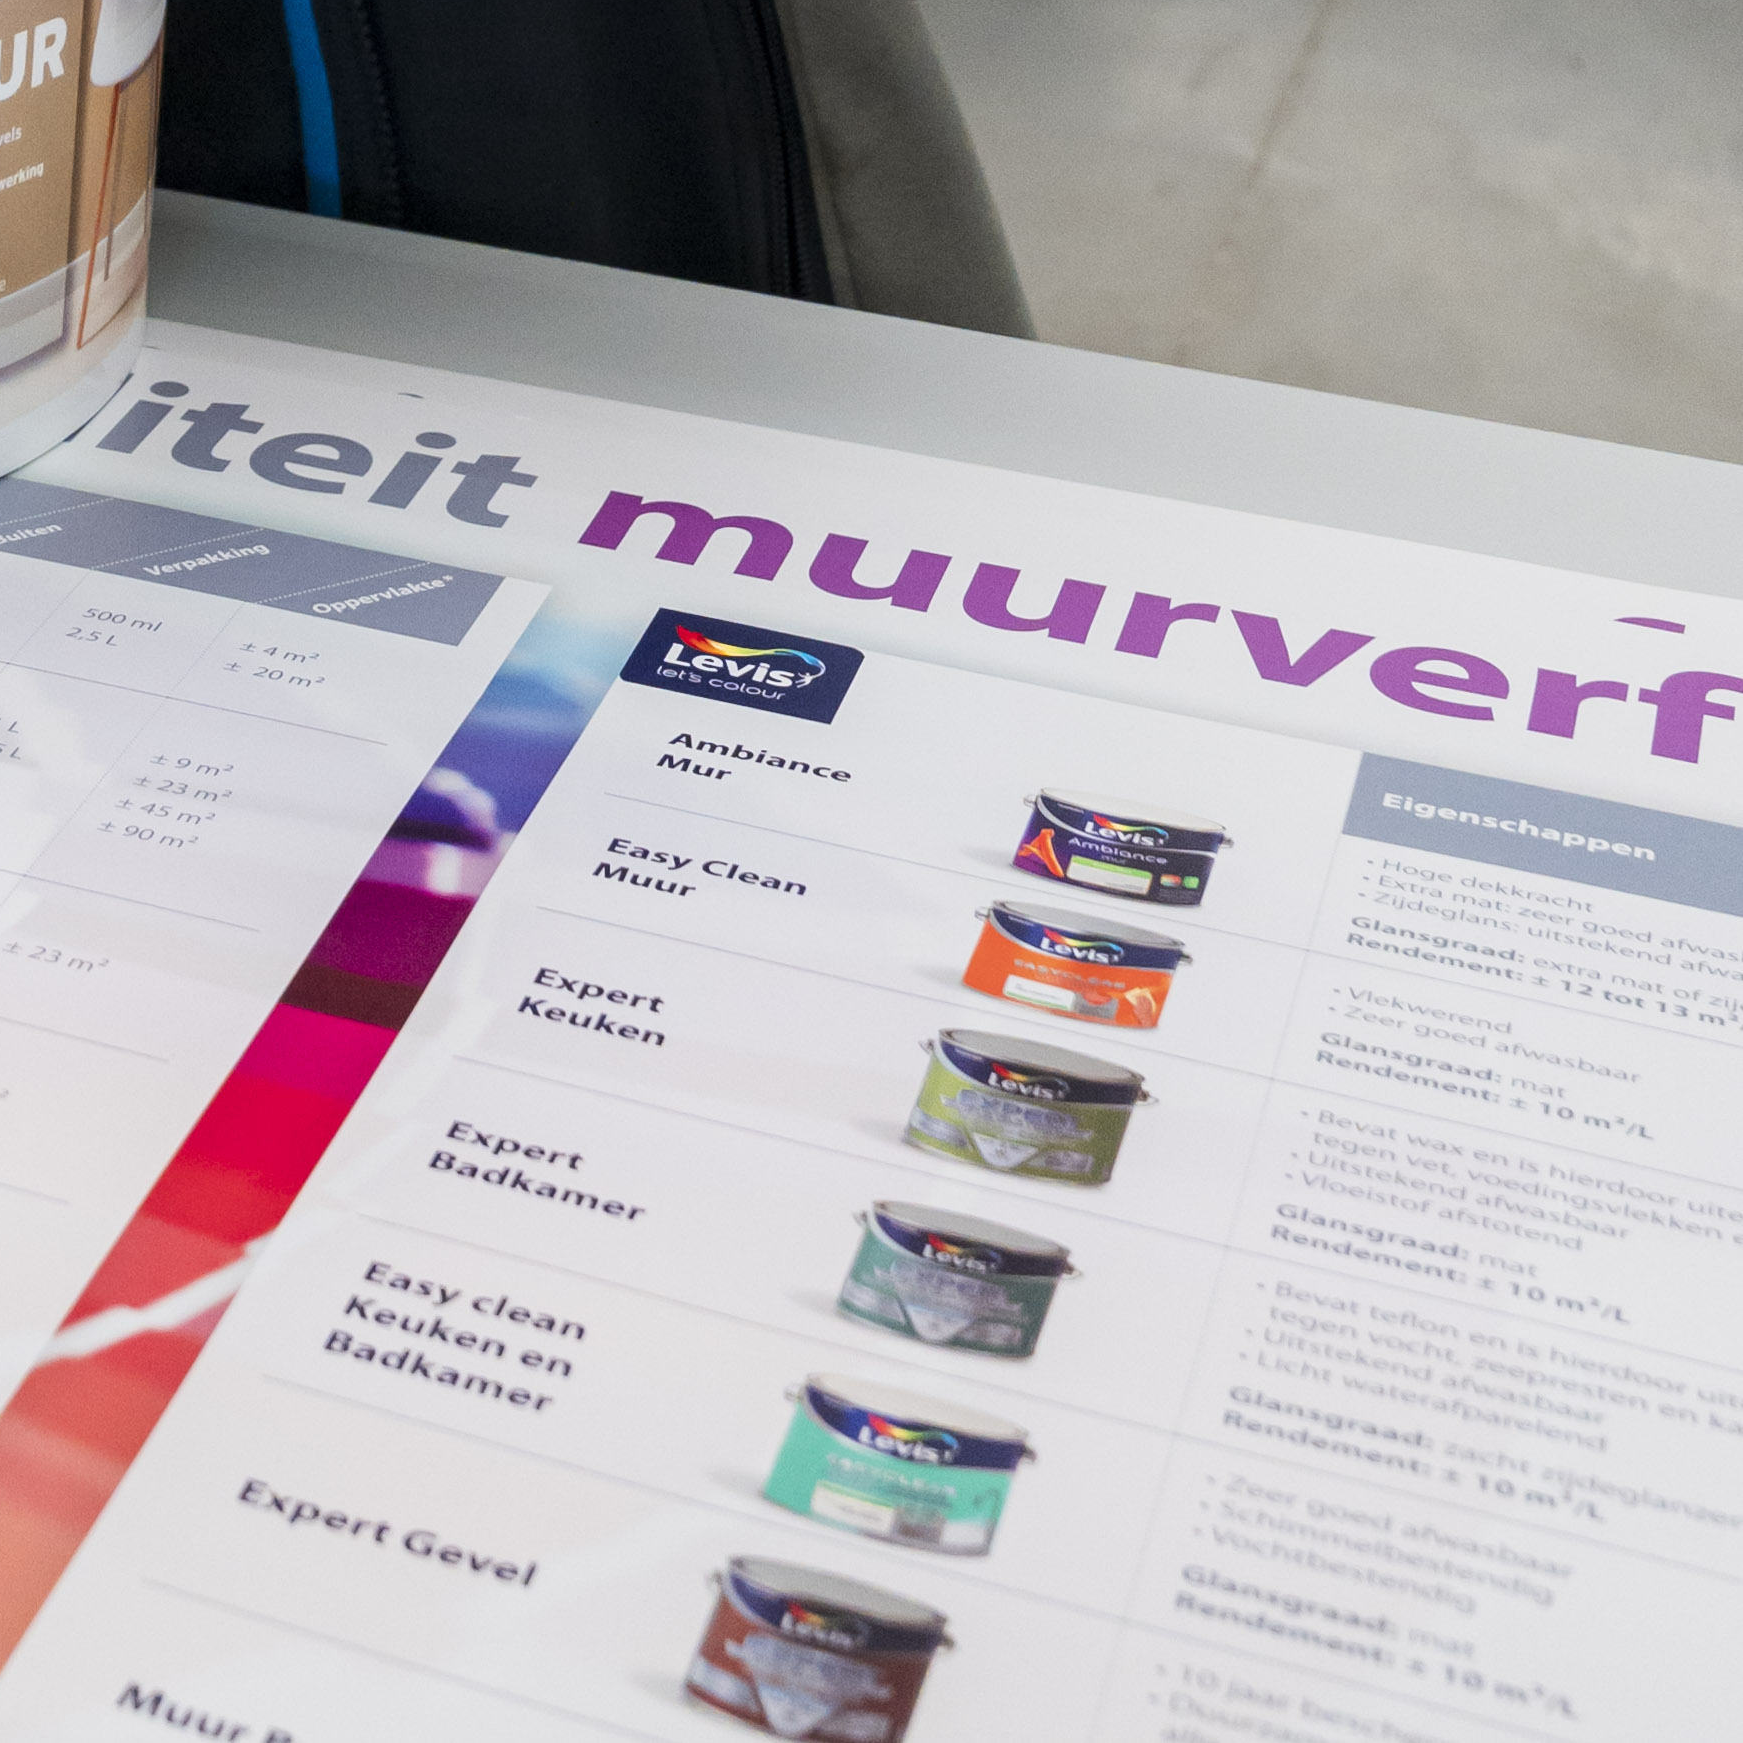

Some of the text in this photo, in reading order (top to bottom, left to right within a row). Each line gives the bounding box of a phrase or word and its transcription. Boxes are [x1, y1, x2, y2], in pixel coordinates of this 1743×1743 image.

[96, 381, 1743, 764] iteit muurverf
[144, 542, 270, 578] Verpakking
[66, 627, 326, 689] 2,5 L ± 20 m²
[83, 608, 320, 664] 500 ml ± 4 m²
[657, 666, 785, 700] let's colour
[663, 643, 793, 688] Levis
[150, 753, 235, 778] ± 9 m²
[657, 753, 732, 781] Mur
[669, 733, 852, 782] Ambiance
[1069, 836, 1168, 864] Ambiance
[1085, 821, 1155, 846] Levis
[1382, 792, 1656, 861] Eigenschappen
[592, 862, 696, 897] Muur
[607, 837, 807, 896] Easy Clean
[1382, 858, 1593, 913] Hoge dekkracht
[1040, 937, 1109, 963] Levis
[534, 968, 664, 1012] Expert
[1348, 987, 1513, 1035] Vlekwerend
[518, 996, 665, 1047] Keuken
[1343, 1005, 1642, 1084] Zeer goed afwasbaar
[988, 1073, 1055, 1098] Levis
[1321, 1032, 1567, 1098] Glansgraad: mat
[446, 1121, 583, 1171] Expert
[429, 1151, 647, 1221] Badkamer
[363, 1260, 586, 1341] Easy clean
[344, 1295, 572, 1377] Keuken en
[323, 1330, 553, 1410] Badkamer
[237, 1477, 538, 1587] Expert Gevel
[116, 1682, 250, 1742] Muur
